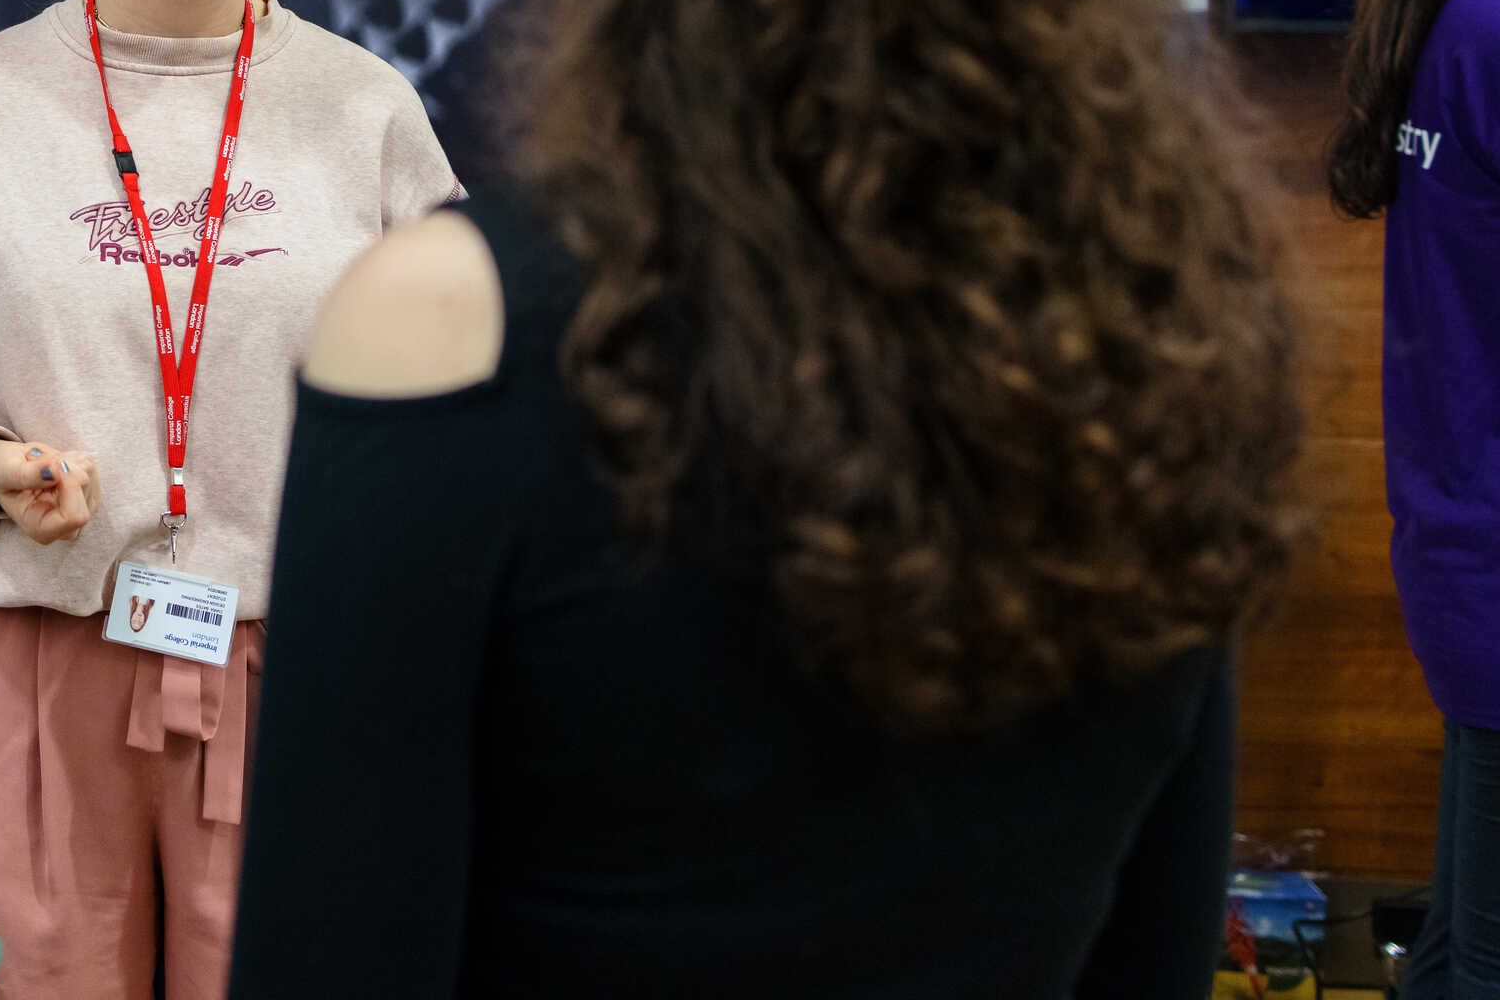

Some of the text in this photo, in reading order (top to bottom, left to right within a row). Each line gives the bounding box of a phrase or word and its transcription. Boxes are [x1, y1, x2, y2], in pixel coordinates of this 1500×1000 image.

[1395, 120, 1442, 170] stry
[100, 243, 200, 268] Rebok
[189, 303, 199, 328] London
[165, 328, 173, 353] London
